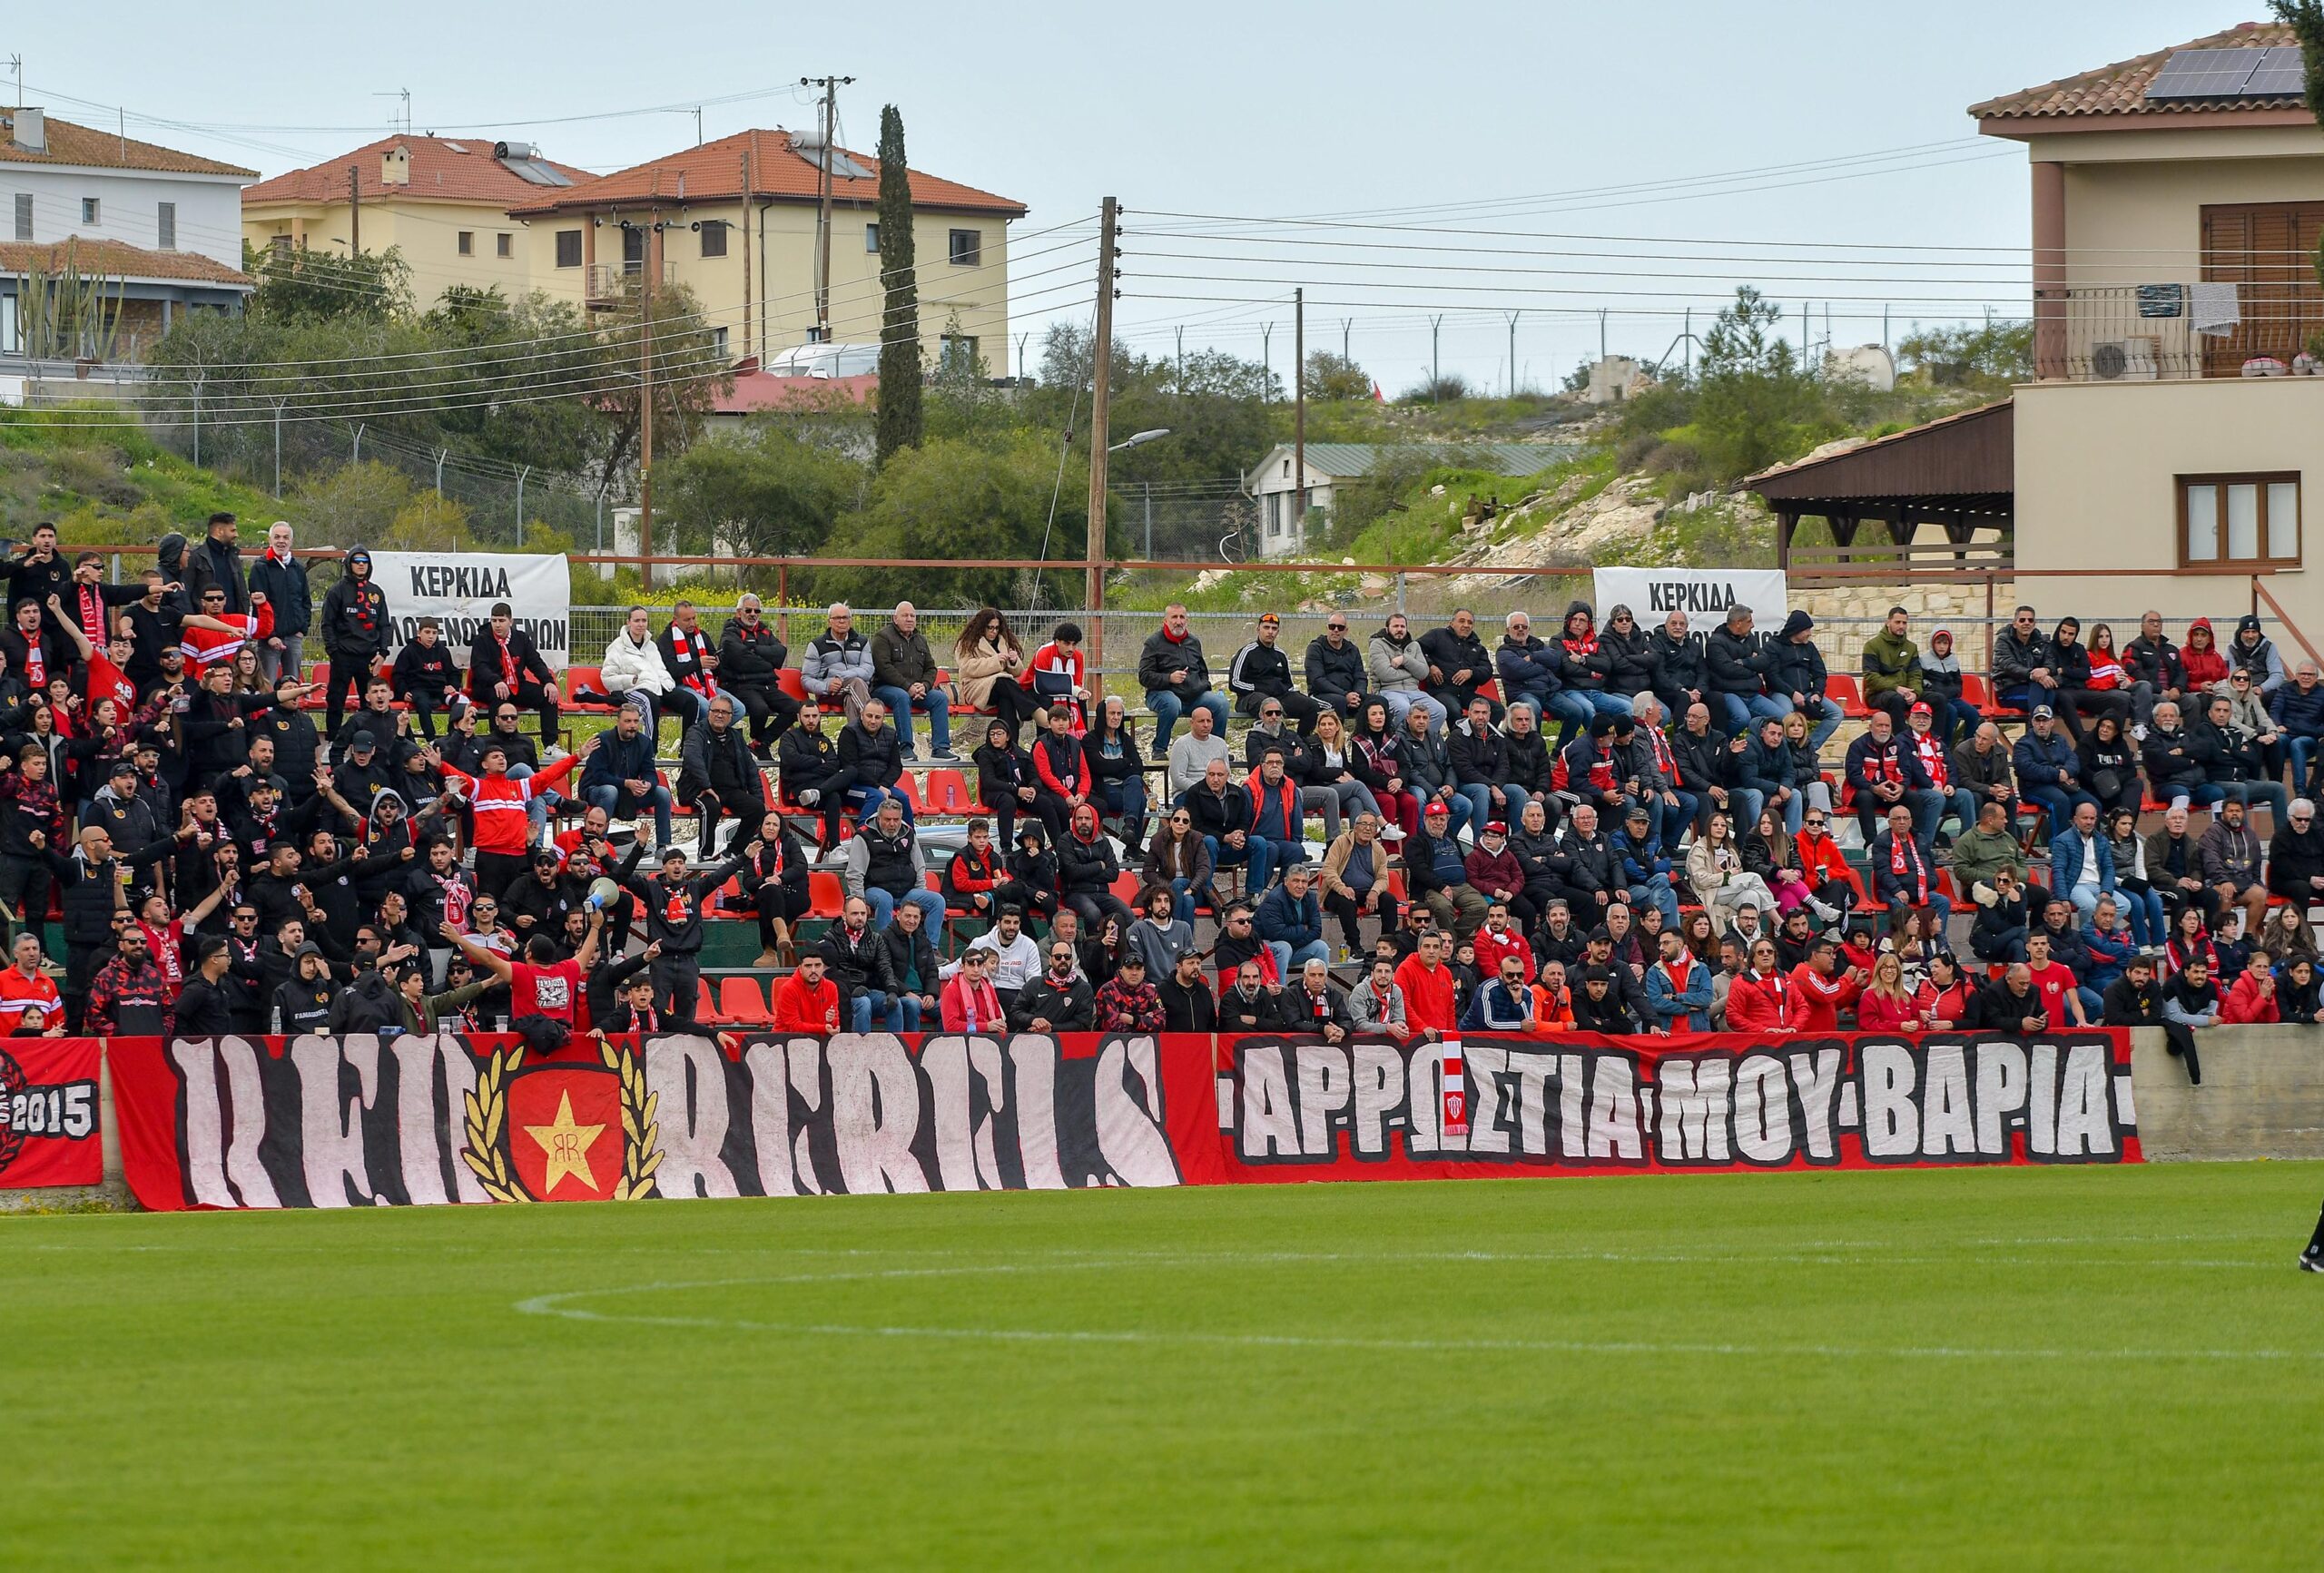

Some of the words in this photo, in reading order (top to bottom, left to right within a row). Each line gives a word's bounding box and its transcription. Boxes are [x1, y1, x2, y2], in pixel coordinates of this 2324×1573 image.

[410, 565, 513, 598] ΚΕΡΚΙΔΑ
[1648, 582, 1737, 612] ΚΕΡΚΙΔΑ
[12, 1085, 92, 1136] 2015
